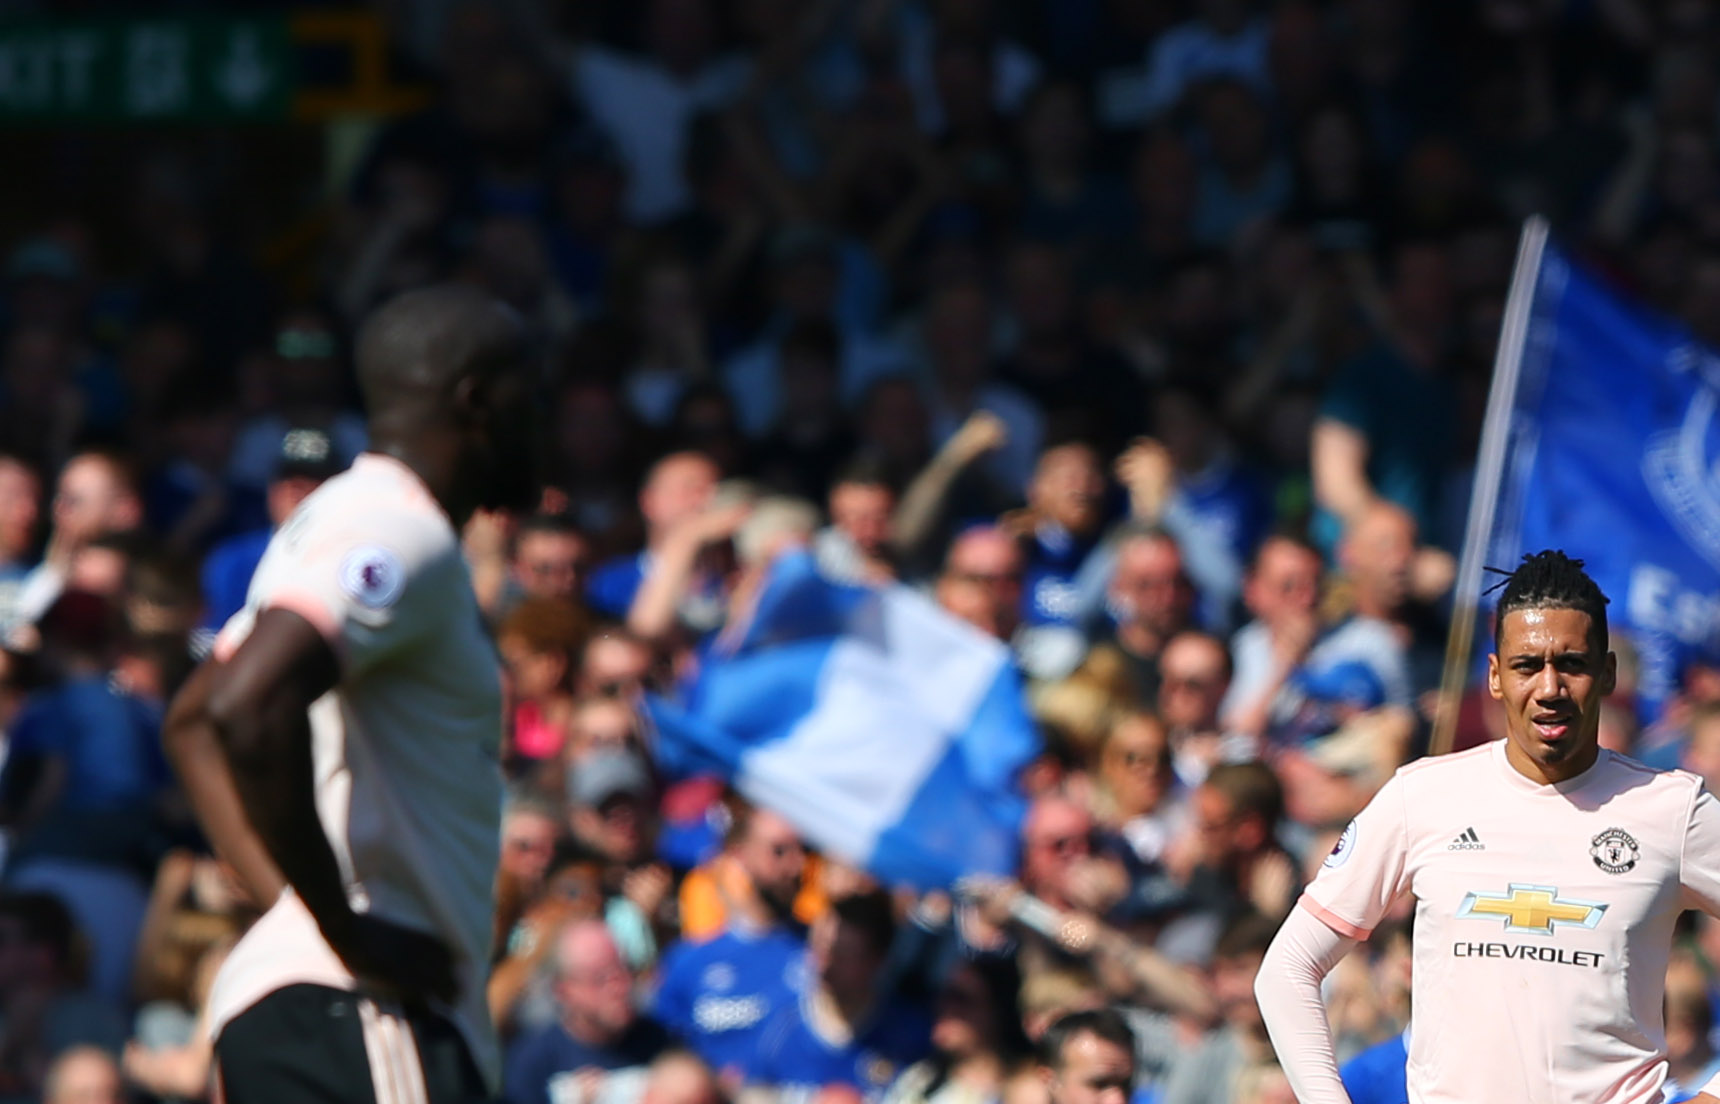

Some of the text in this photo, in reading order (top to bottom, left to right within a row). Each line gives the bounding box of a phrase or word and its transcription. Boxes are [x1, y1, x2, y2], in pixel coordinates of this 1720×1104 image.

[1448, 842, 1485, 851] adidas
[1594, 830, 1637, 849] MANCHESTER
[1600, 861, 1630, 873] UNITED
[1453, 942, 1605, 968] CHEVROLET
